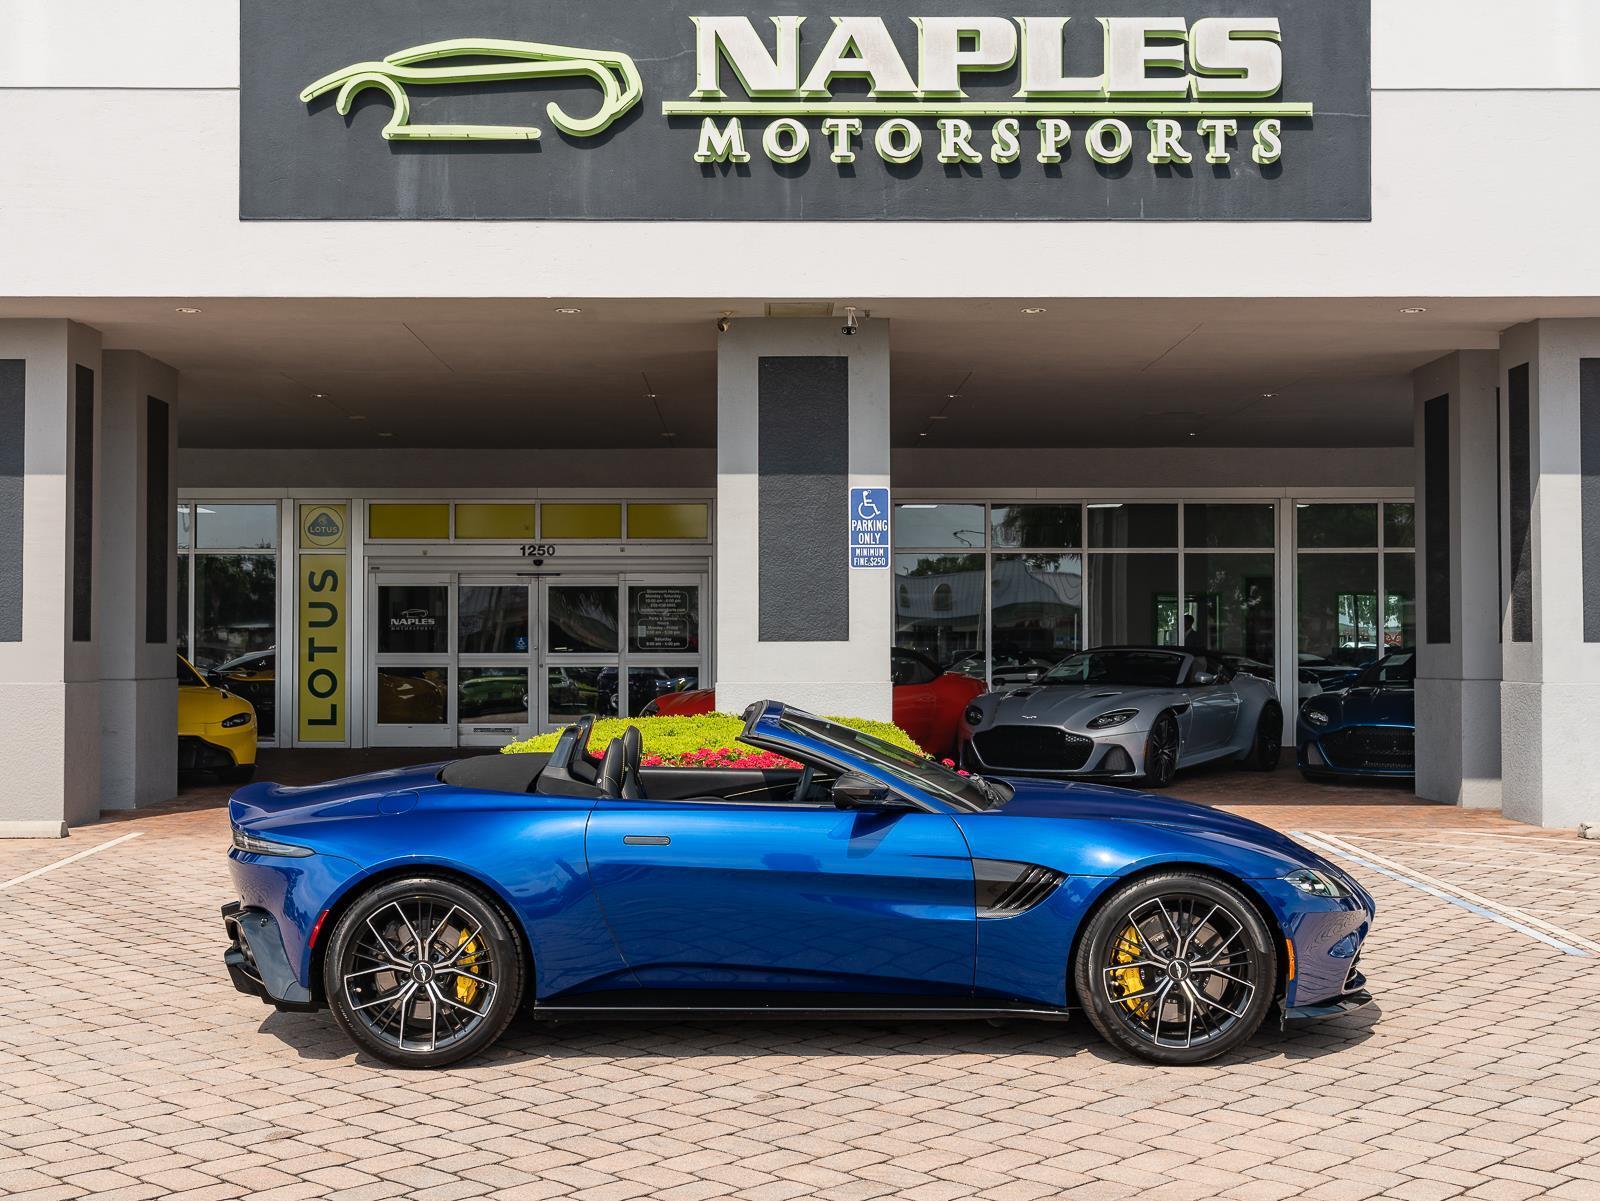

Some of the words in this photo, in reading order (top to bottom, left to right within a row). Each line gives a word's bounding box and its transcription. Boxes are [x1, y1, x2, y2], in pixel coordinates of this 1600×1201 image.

[688, 16, 1283, 99] NAPLES
[693, 117, 1283, 164] MOTORSPORTS
[851, 520, 888, 532] PARKING
[858, 533, 881, 544] ONLY
[520, 545, 556, 557] 1250
[855, 548, 884, 557] MINIMUM
[307, 569, 339, 726] LOTUS
